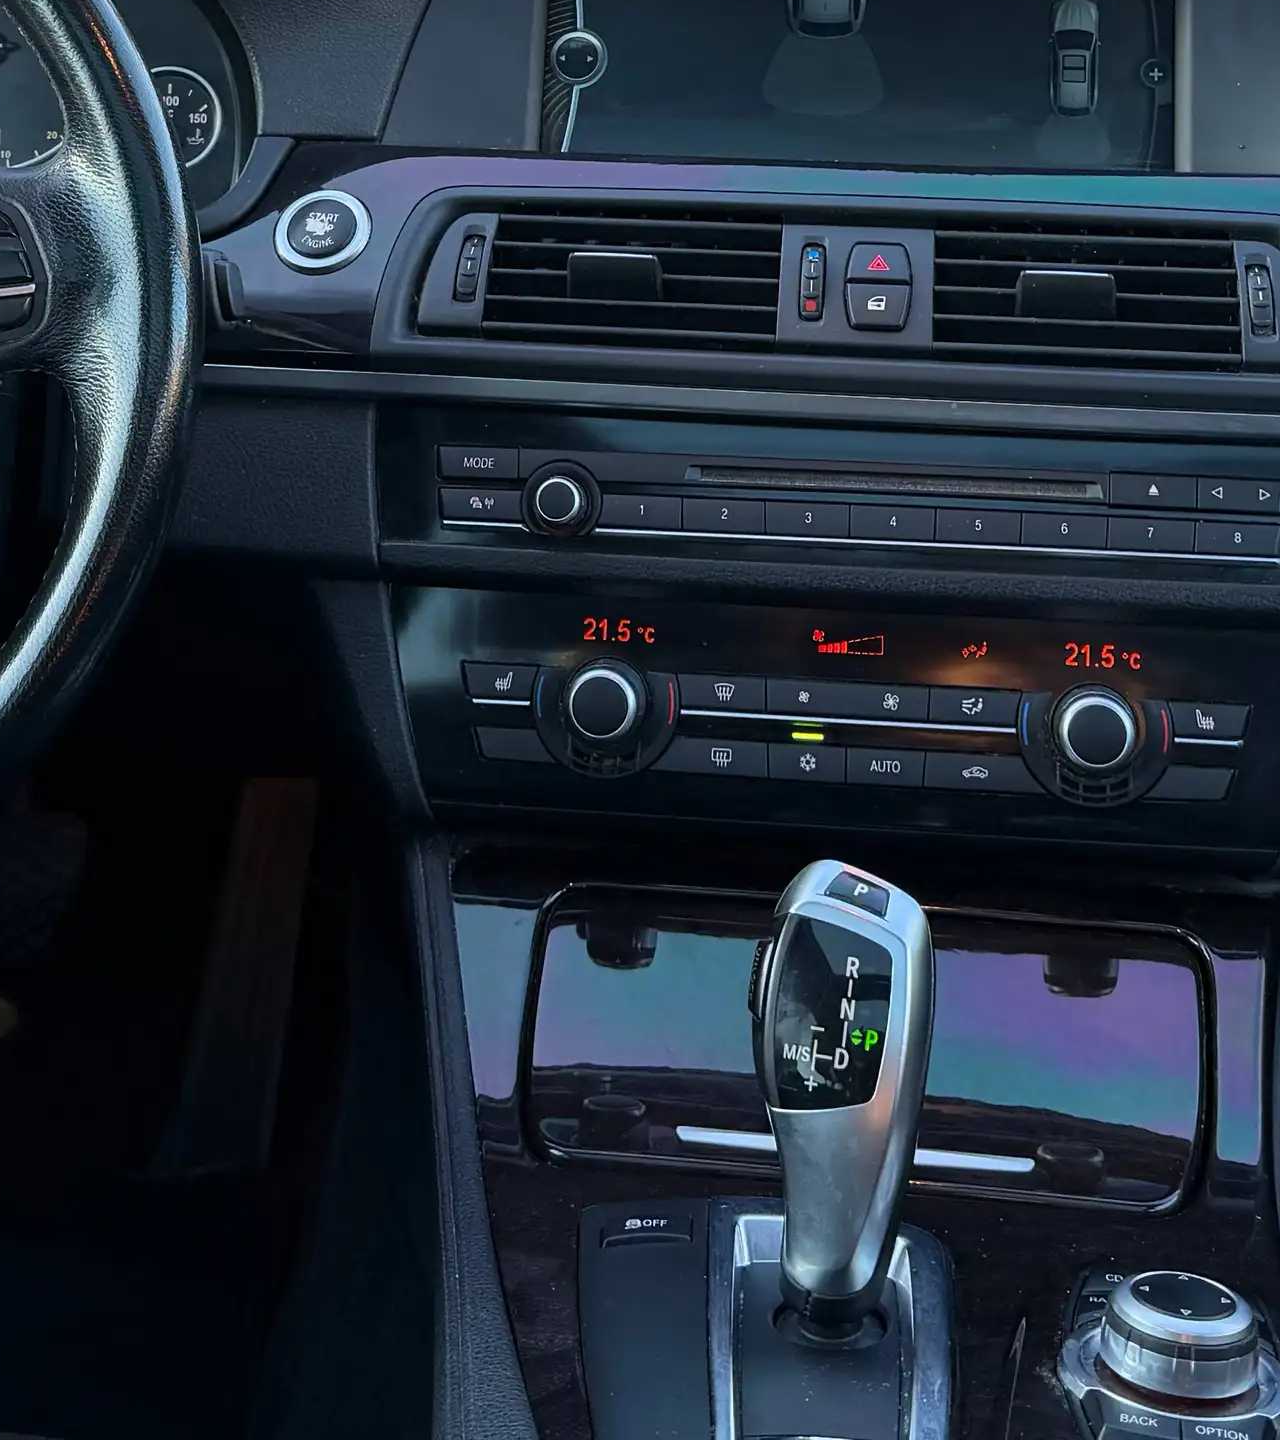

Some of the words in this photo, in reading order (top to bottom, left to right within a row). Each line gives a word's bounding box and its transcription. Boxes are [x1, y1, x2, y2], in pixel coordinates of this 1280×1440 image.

[188, 113, 208, 124] 150
[46, 131, 58, 139] 20
[0, 150, 11, 159] 10
[308, 212, 340, 223] START
[301, 235, 335, 249] ENGINE
[463, 457, 495, 469] MODE
[639, 505, 645, 515] 1
[721, 508, 728, 520] 2
[805, 512, 812, 524] 3
[889, 516, 897, 527] 4
[974, 519, 982, 531] 5
[1061, 522, 1069, 534] 6
[1147, 527, 1155, 539] 7
[1233, 532, 1242, 544] 8
[583, 618, 631, 642] 21.5
[637, 627, 655, 643] °C
[1065, 642, 1115, 668] 21.5
[1122, 652, 1141, 670] °C
[870, 760, 901, 773] AUTO
[853, 882, 869, 896] P
[845, 956, 860, 978] R
[840, 997, 856, 1021] N
[864, 1029, 879, 1051] P
[783, 1043, 811, 1061] M/S
[833, 1047, 849, 1070] D
[642, 1219, 668, 1227] OFF
[1120, 1413, 1158, 1428] BACK
[1195, 1425, 1249, 1440] OPTION
